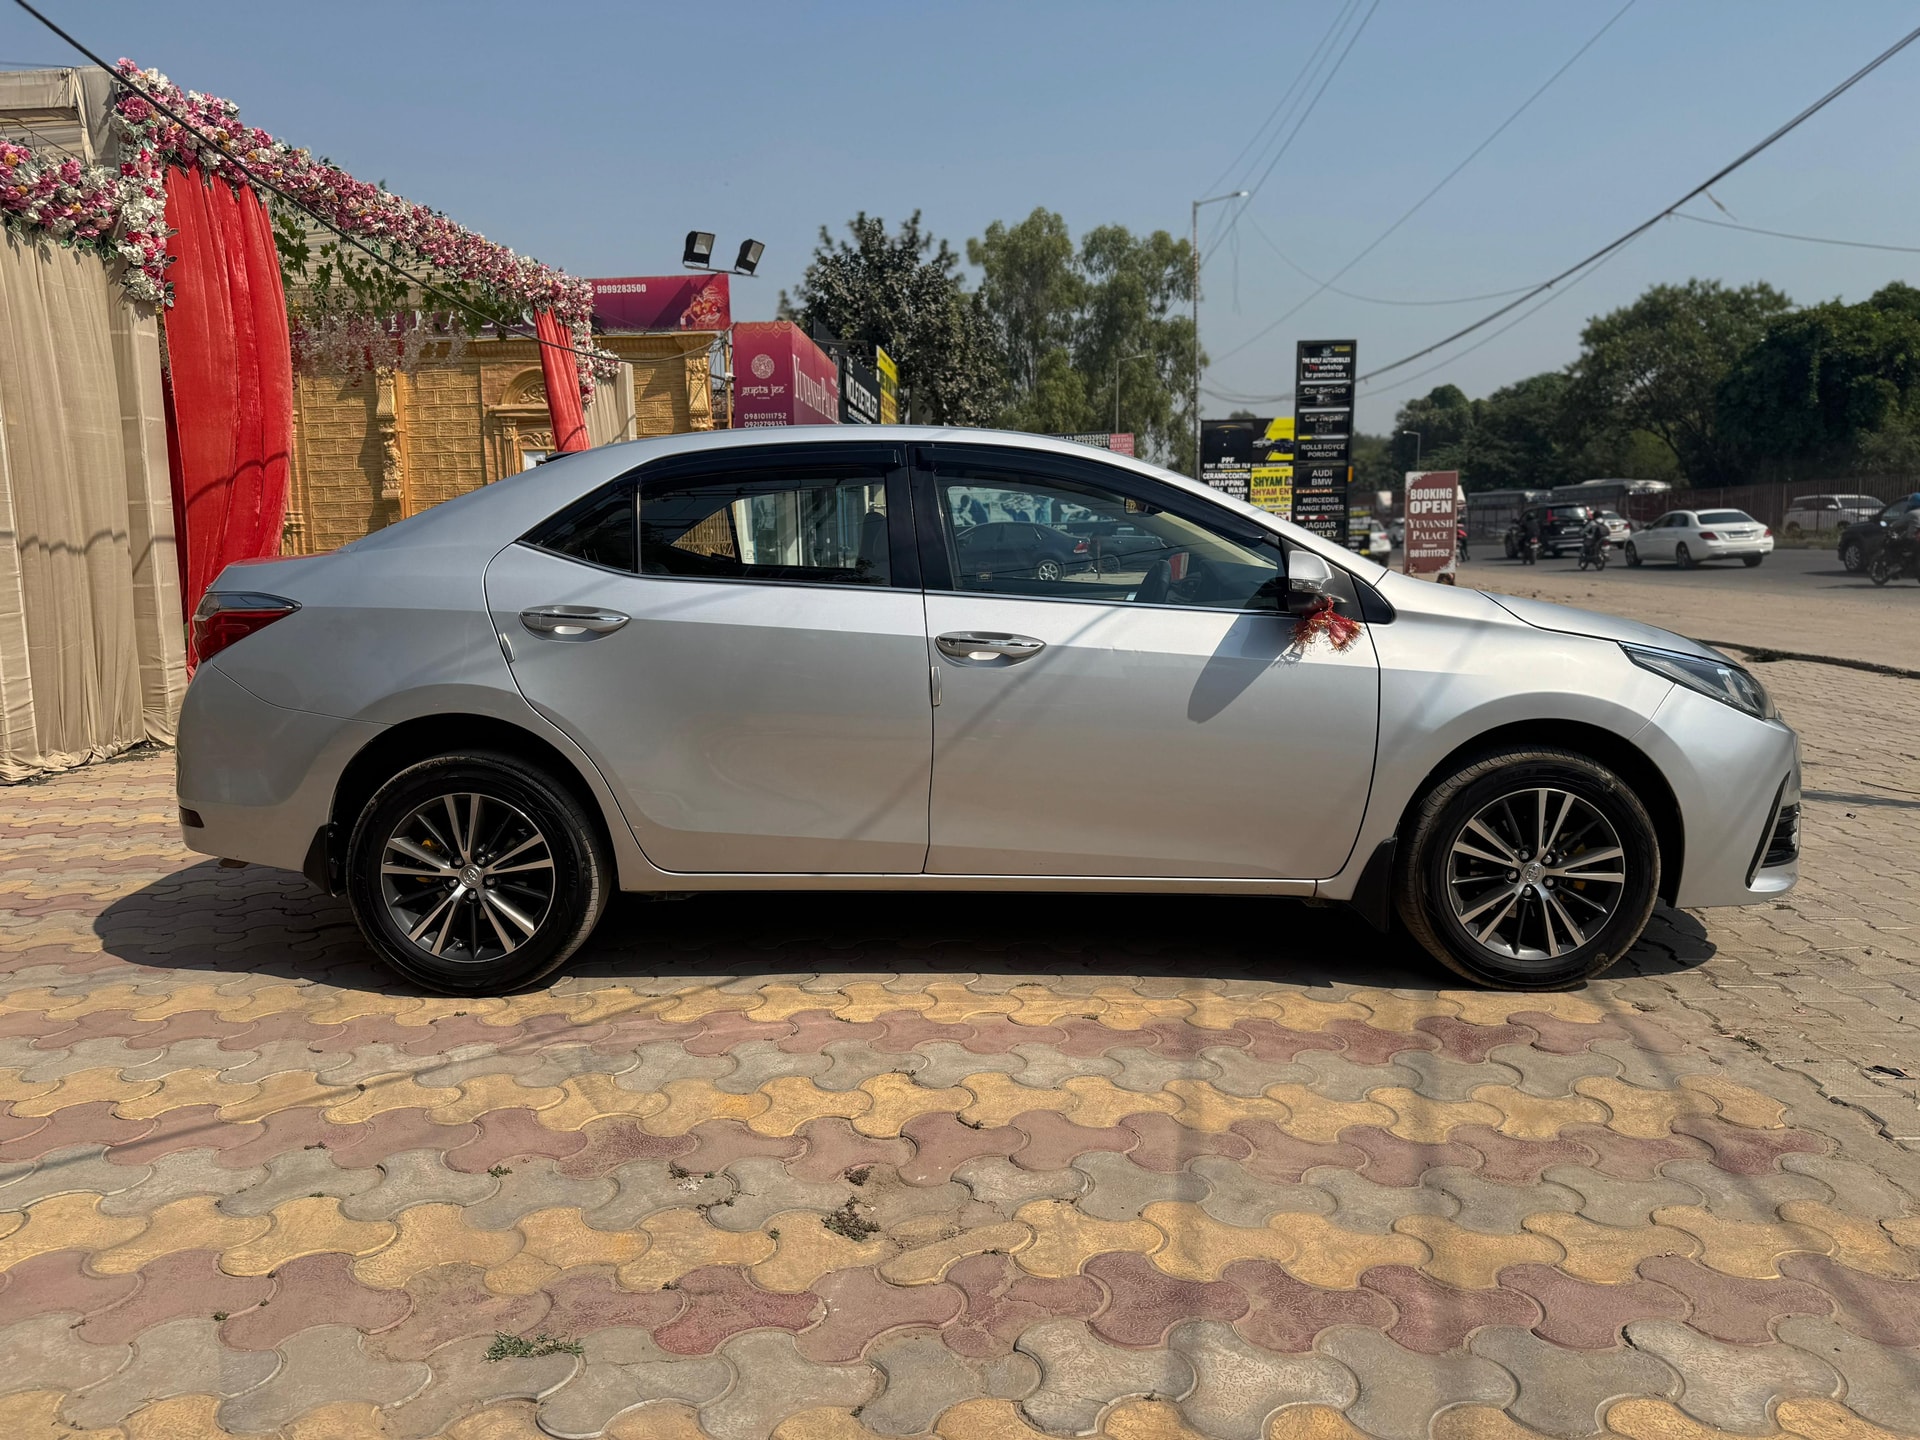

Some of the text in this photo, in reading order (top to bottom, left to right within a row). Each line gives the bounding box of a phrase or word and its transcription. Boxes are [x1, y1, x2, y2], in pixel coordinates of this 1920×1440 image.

[597, 284, 647, 294] 9999283500
[743, 412, 787, 420] 09810111752
[1311, 469, 1333, 477] AUDI
[1253, 476, 1283, 487] SHYAM
[1311, 478, 1333, 486] BMW
[1251, 488, 1277, 496] SHYAM
[1410, 488, 1453, 500] BOOKING
[1410, 500, 1452, 513] OPEN
[1304, 521, 1337, 529] JAGUAR
[1412, 530, 1449, 540] PALACE
[1409, 549, 1450, 558] 9810111752
